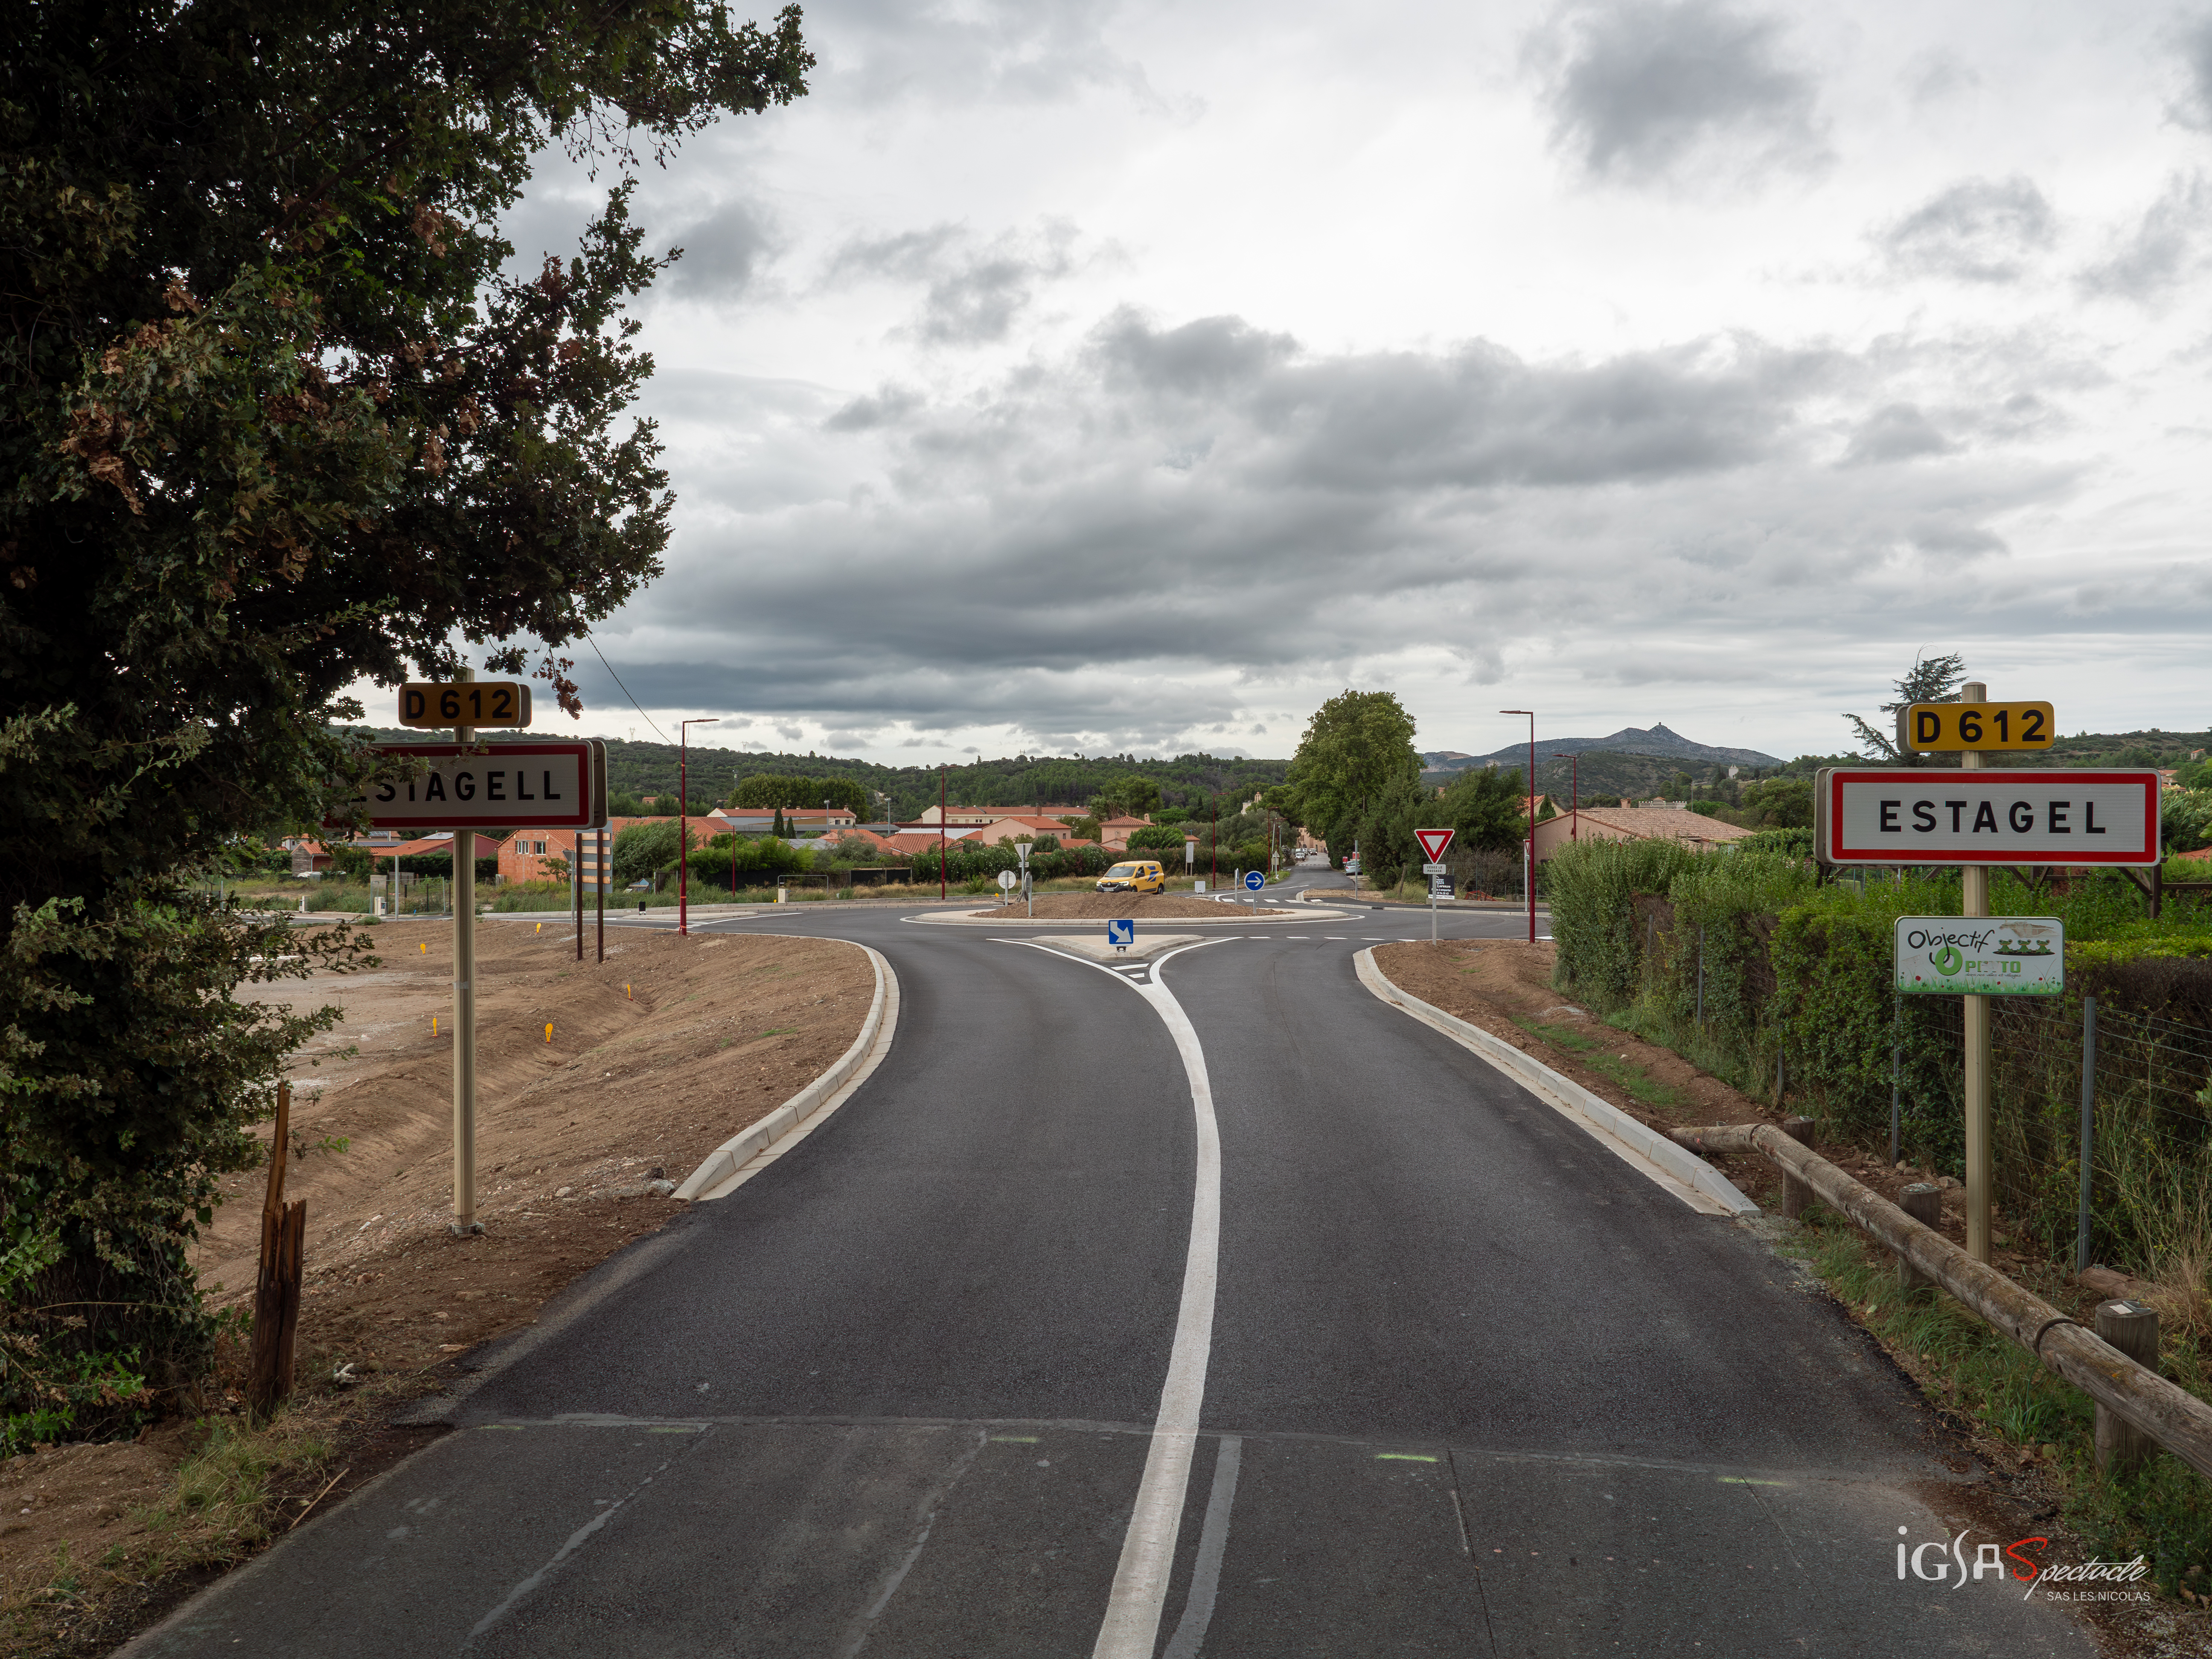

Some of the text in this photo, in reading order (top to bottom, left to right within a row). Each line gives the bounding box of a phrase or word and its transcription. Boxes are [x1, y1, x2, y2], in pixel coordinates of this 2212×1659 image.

[405, 689, 512, 719] D 612
[1917, 710, 2046, 743] D 612
[350, 771, 561, 802] SAGELL
[1880, 800, 2106, 834] ESTAGEL
[1907, 927, 1995, 965] Objectif
[1965, 960, 2021, 973] PTO
